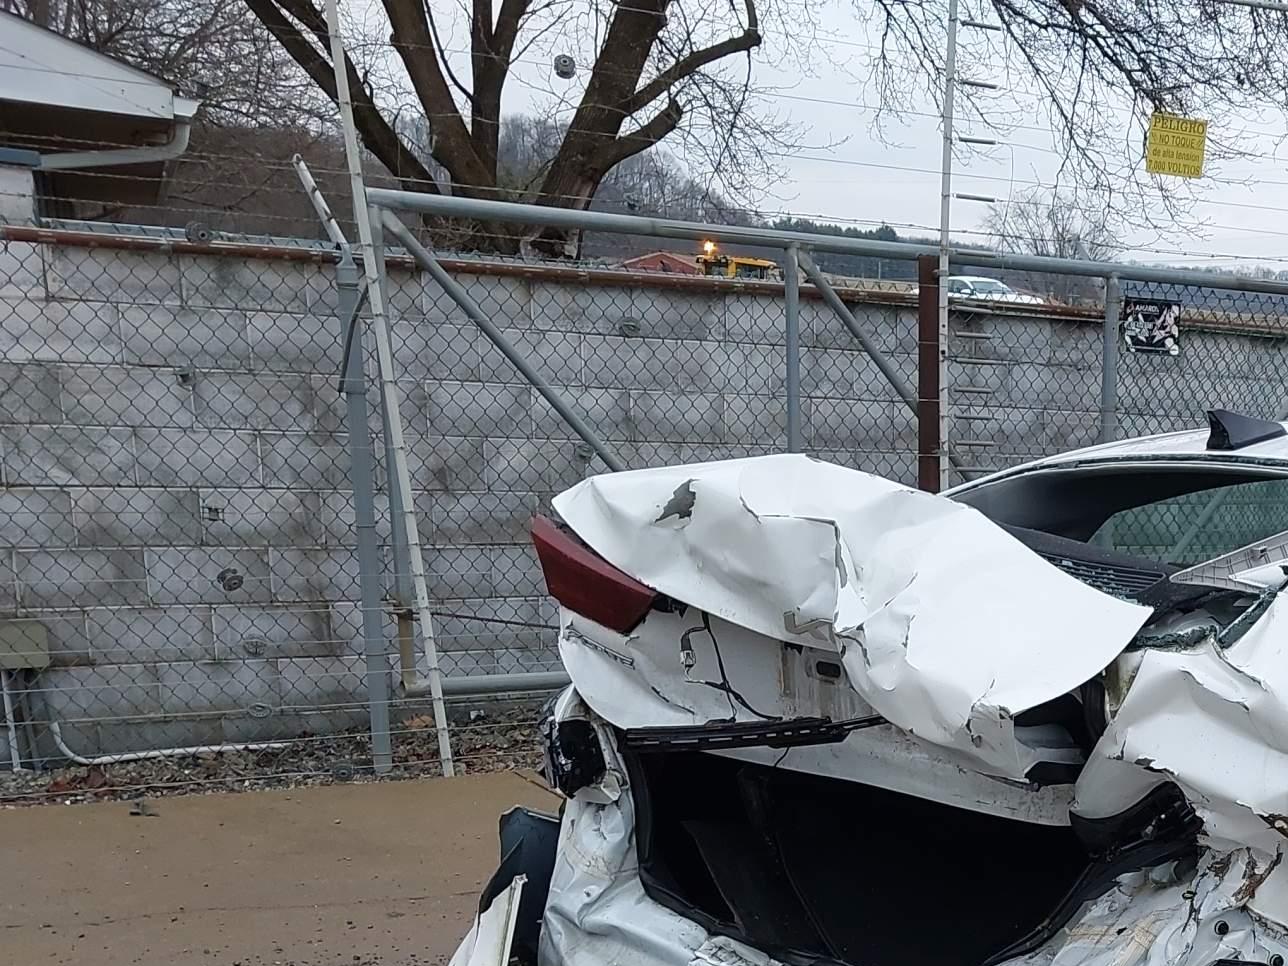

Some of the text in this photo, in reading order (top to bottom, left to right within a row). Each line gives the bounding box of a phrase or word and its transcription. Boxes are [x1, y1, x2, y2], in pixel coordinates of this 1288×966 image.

[1153, 117, 1205, 135] PELIGRO
[1159, 134, 1195, 149] NO TOQUE
[1152, 148, 1161, 157] de
[1162, 149, 1174, 158] alta
[1168, 161, 1201, 176] VOLTIOS
